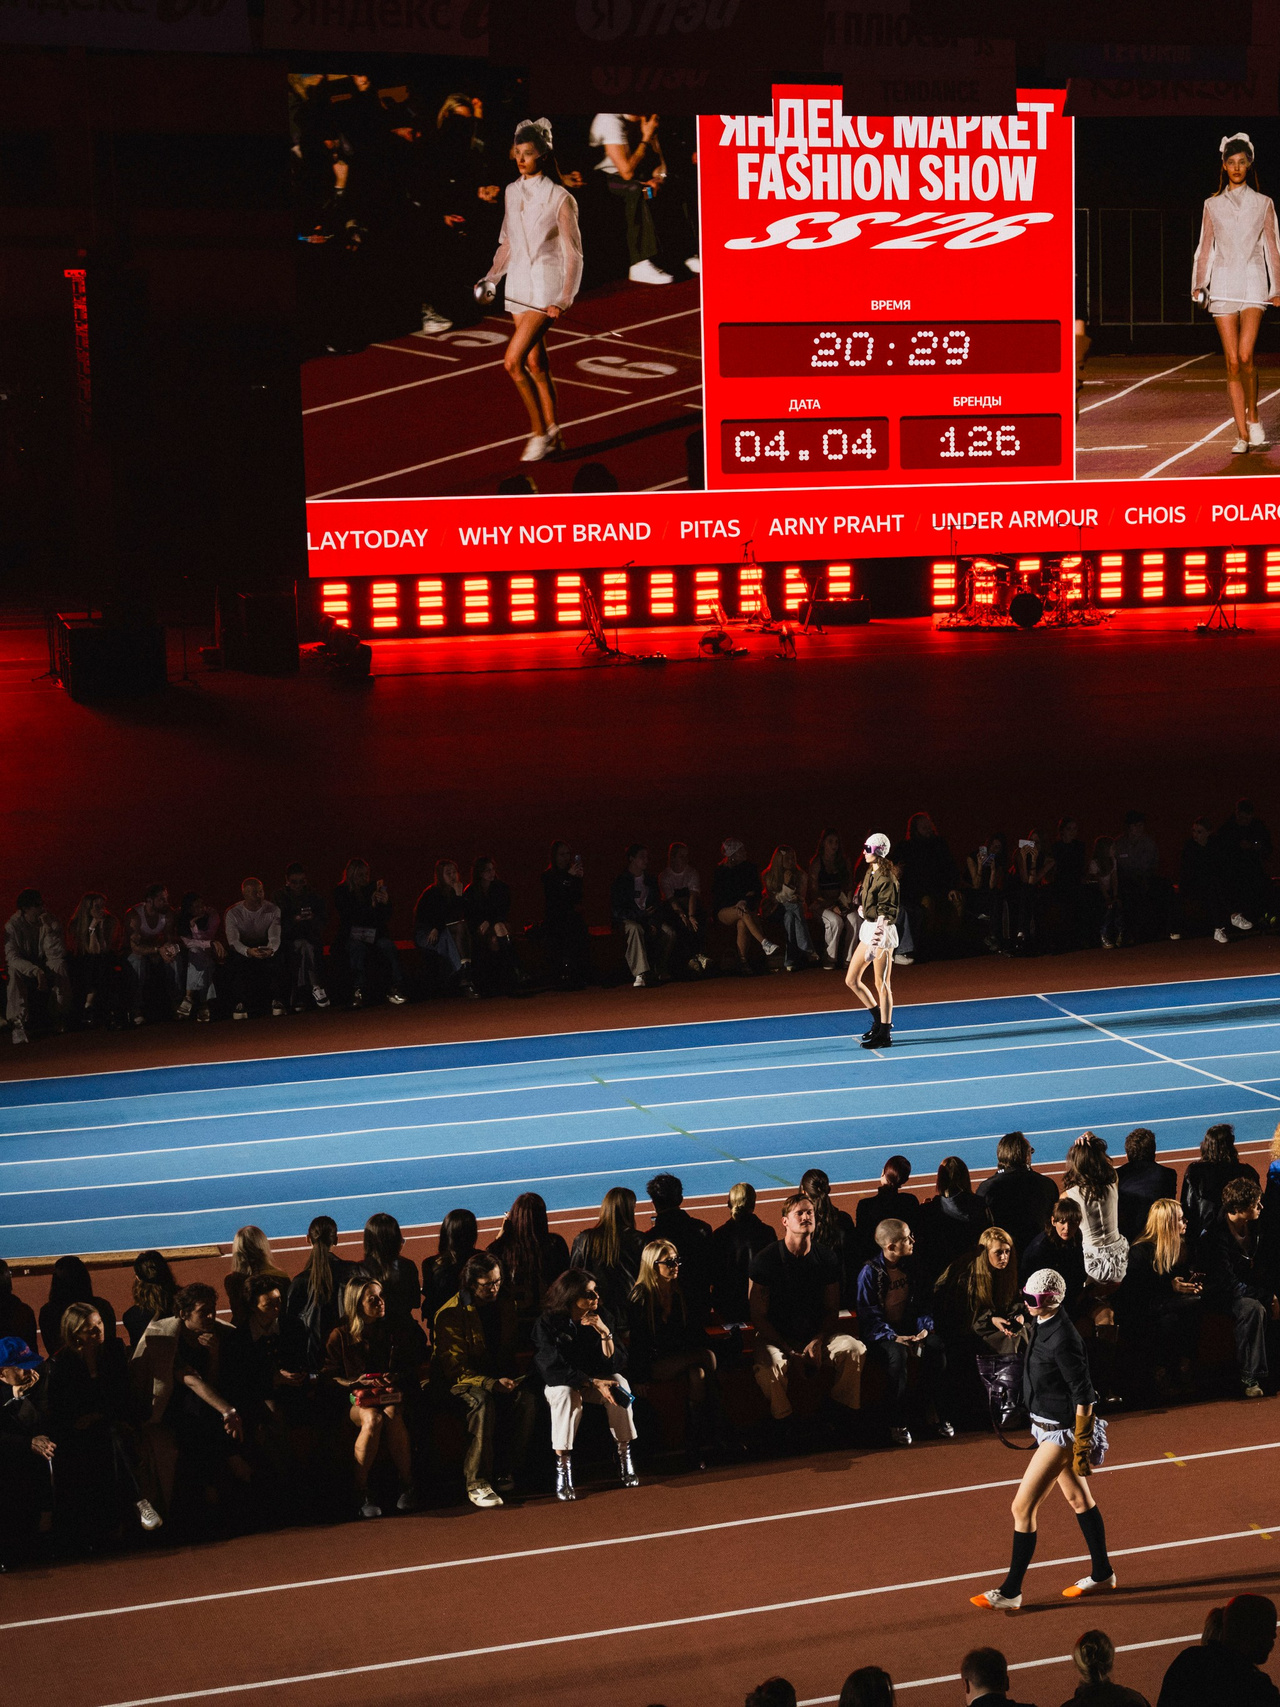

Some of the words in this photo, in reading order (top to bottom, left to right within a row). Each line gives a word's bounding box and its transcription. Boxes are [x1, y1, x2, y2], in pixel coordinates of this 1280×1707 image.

[719, 98, 884, 154] ЯНДЕКС
[893, 103, 1055, 150] МАРКЕТ
[737, 153, 910, 201] FASHION
[918, 155, 1037, 202] SHOW
[870, 300, 911, 311] ВРЕМЯ
[811, 330, 971, 367] 20:29
[788, 399, 821, 412] ДАТА
[953, 396, 1002, 408] БРЕНДЫ
[735, 428, 877, 462] 04.04
[939, 425, 1021, 457] 126
[768, 516, 828, 536] ARNY
[833, 514, 905, 534] PRAHT
[932, 511, 1004, 531] UNDER
[1008, 508, 1099, 529] ARMOUR
[1124, 505, 1186, 525] CHOIS
[306, 528, 429, 551] LAYTODAY
[458, 526, 513, 546] WHY
[519, 525, 567, 544] NOT
[572, 522, 651, 543] BRAND
[680, 519, 741, 539] PITAS
